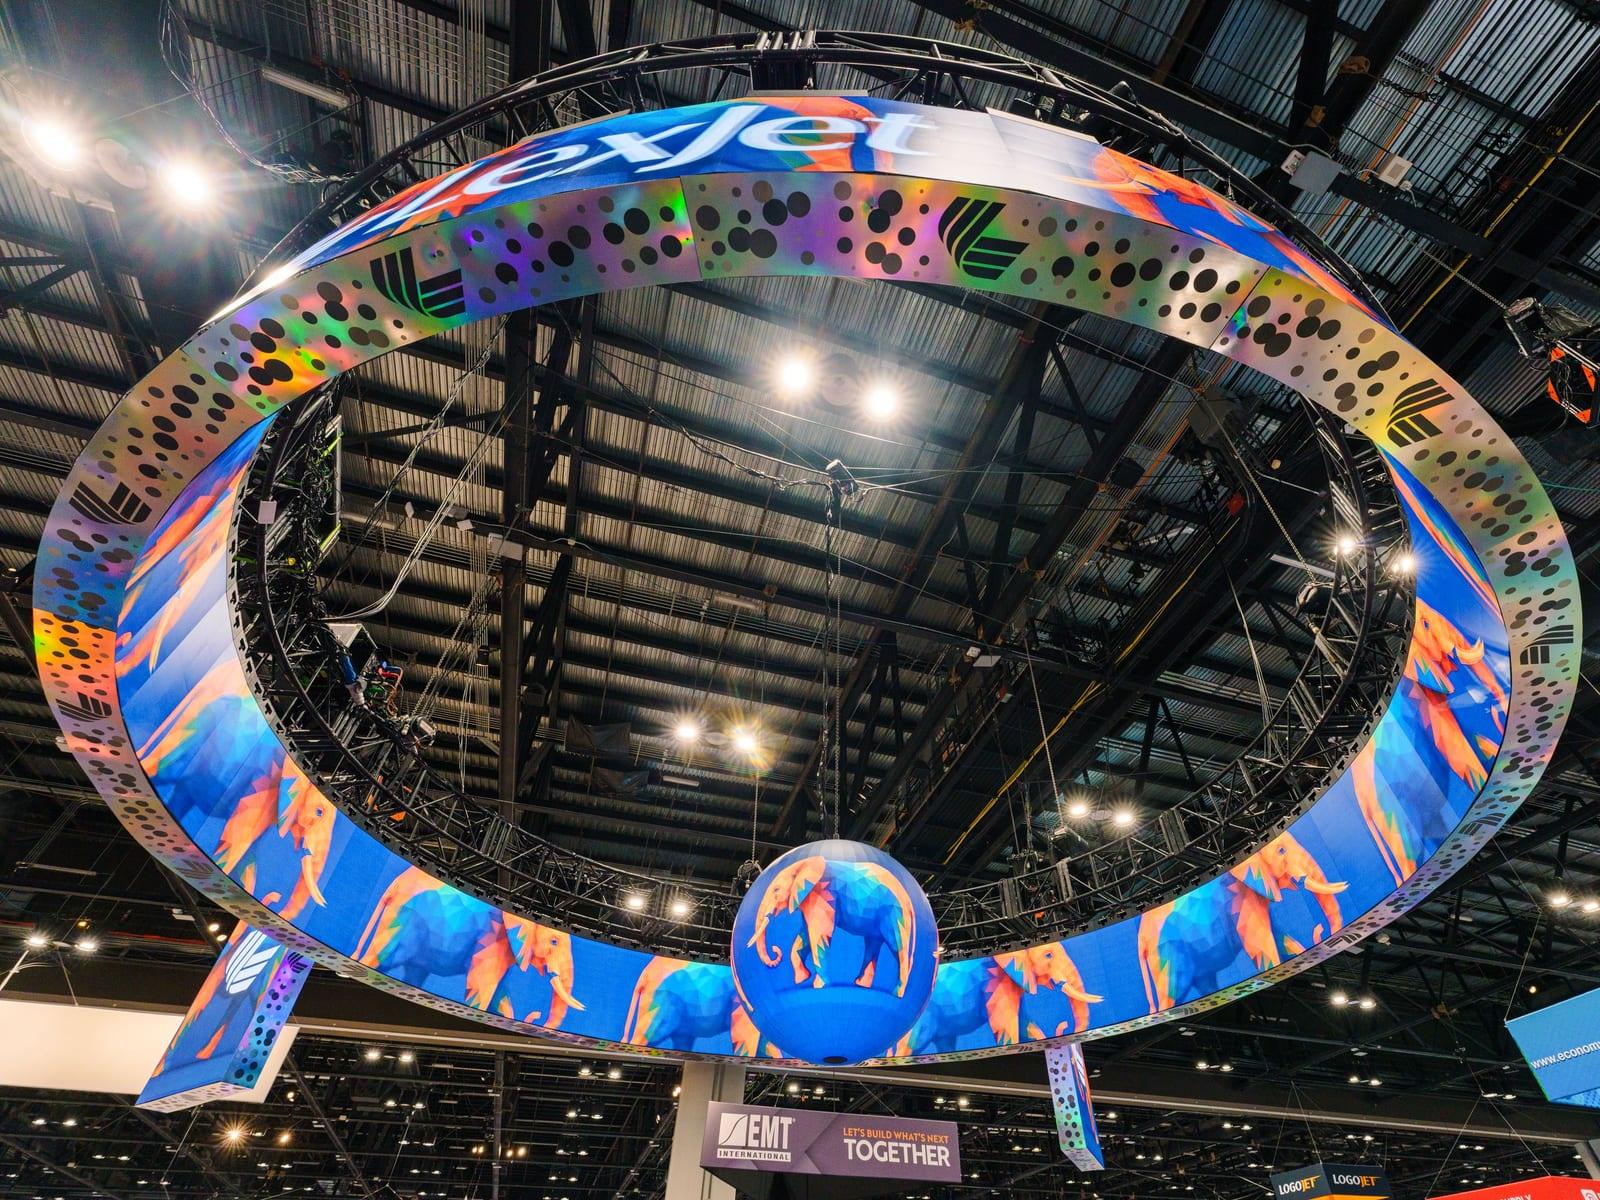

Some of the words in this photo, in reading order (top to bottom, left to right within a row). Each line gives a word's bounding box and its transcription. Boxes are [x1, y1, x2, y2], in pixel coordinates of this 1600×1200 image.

[843, 1127, 865, 1137] LET'S
[866, 1129, 892, 1139] BUILD
[893, 1131, 925, 1142] WHAT'S
[927, 1134, 949, 1144] NEXT
[719, 1150, 790, 1160] INTERNATIONAL
[843, 1138, 951, 1168] TOGETHER
[1278, 1174, 1320, 1195] LOGOJET
[1332, 1174, 1381, 1187] LOGOJET
